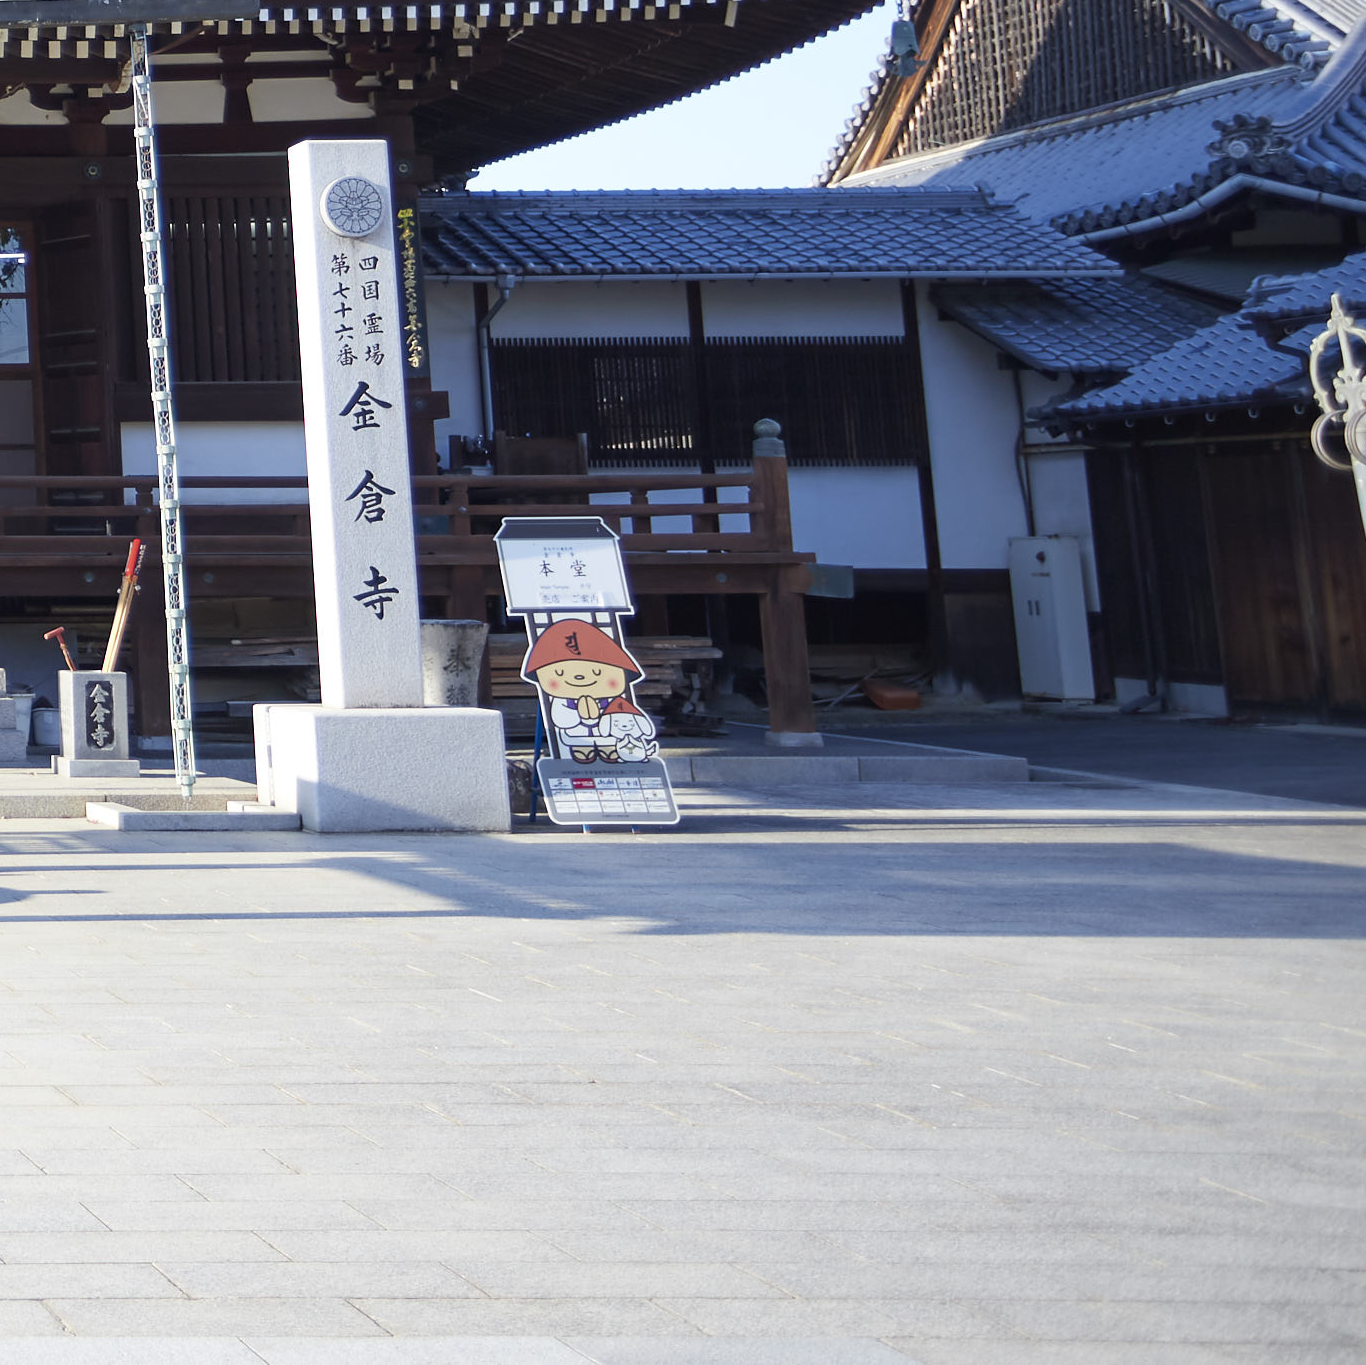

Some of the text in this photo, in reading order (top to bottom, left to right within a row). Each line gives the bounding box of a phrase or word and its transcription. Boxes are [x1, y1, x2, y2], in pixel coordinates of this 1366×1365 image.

[330, 253, 358, 367] 第七十六番
[358, 255, 385, 366] 四国霊場
[338, 381, 399, 620] 金倉寺
[540, 560, 587, 577] 本堂
[89, 683, 111, 747] 金倉寺
